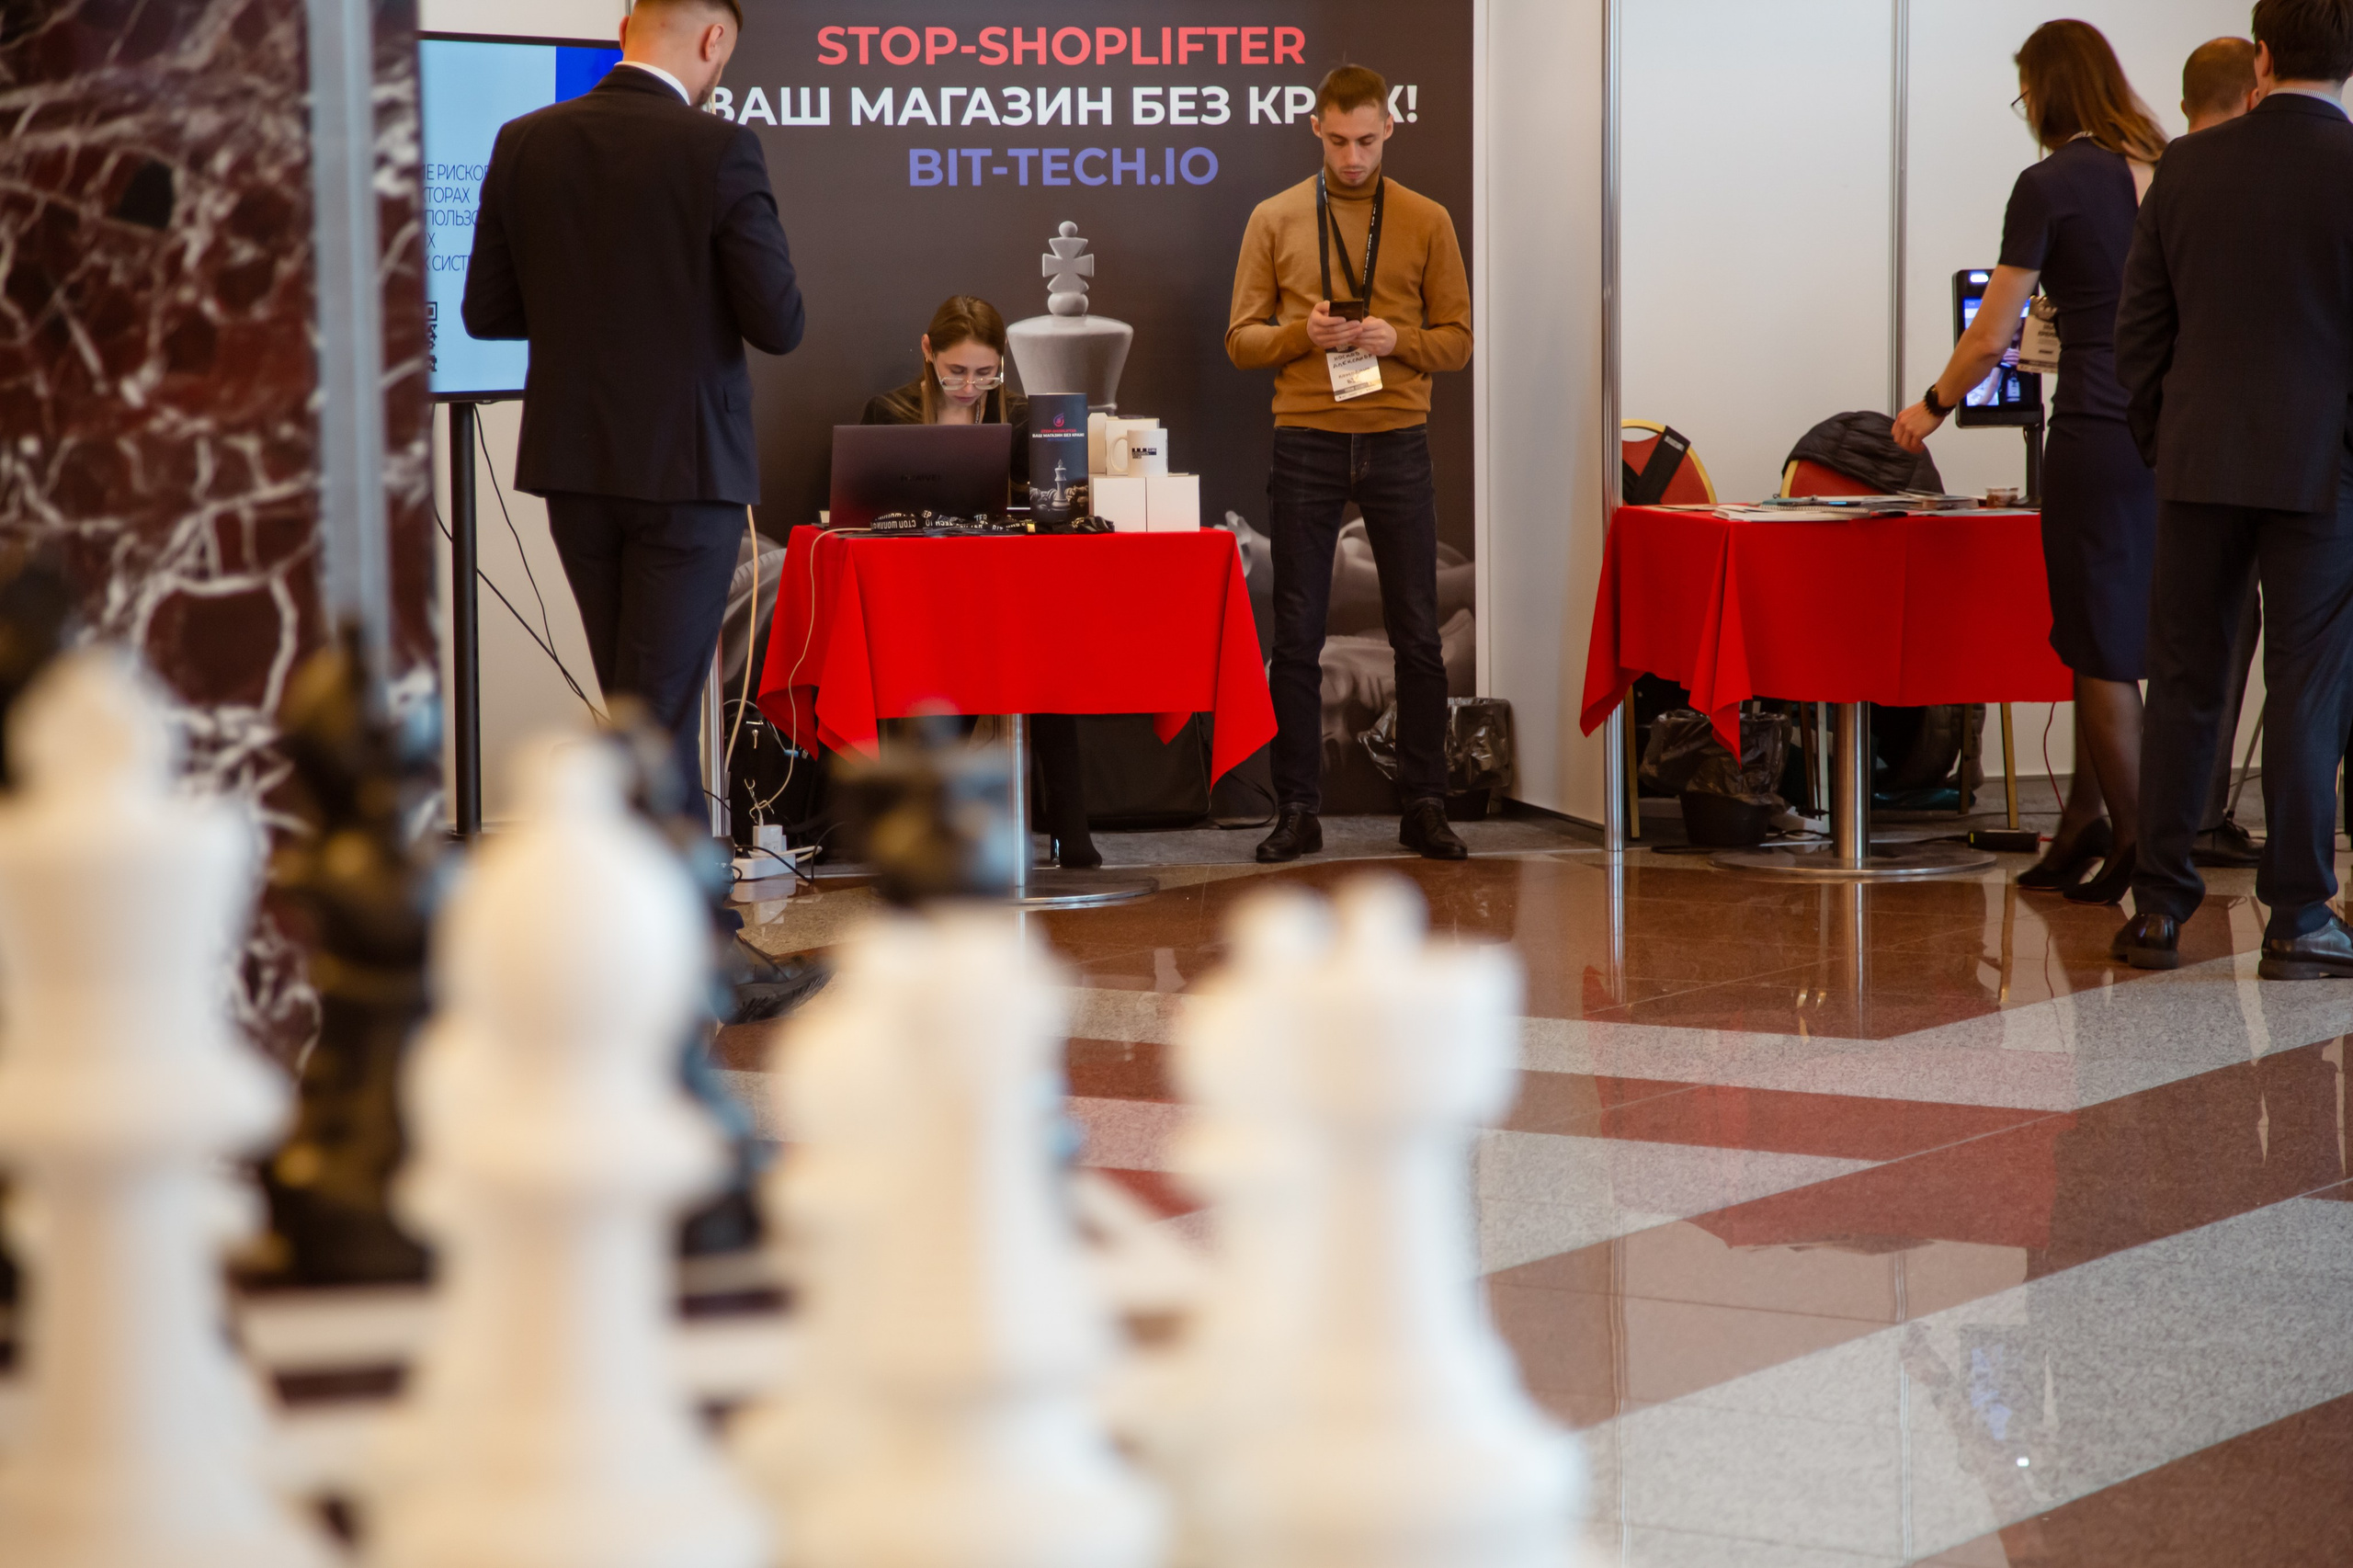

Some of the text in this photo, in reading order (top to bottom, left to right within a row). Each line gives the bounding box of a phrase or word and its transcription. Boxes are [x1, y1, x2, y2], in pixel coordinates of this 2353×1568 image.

[817, 25, 1306, 66] STOP-SHOPLIFTER
[705, 85, 1418, 127] ВАШ МАГАЗИН БЕЗ КР!
[909, 146, 1219, 187] BIT-TECH.IO
[424, 187, 471, 203] ТОРАХ
[432, 255, 471, 271] СИСТ
